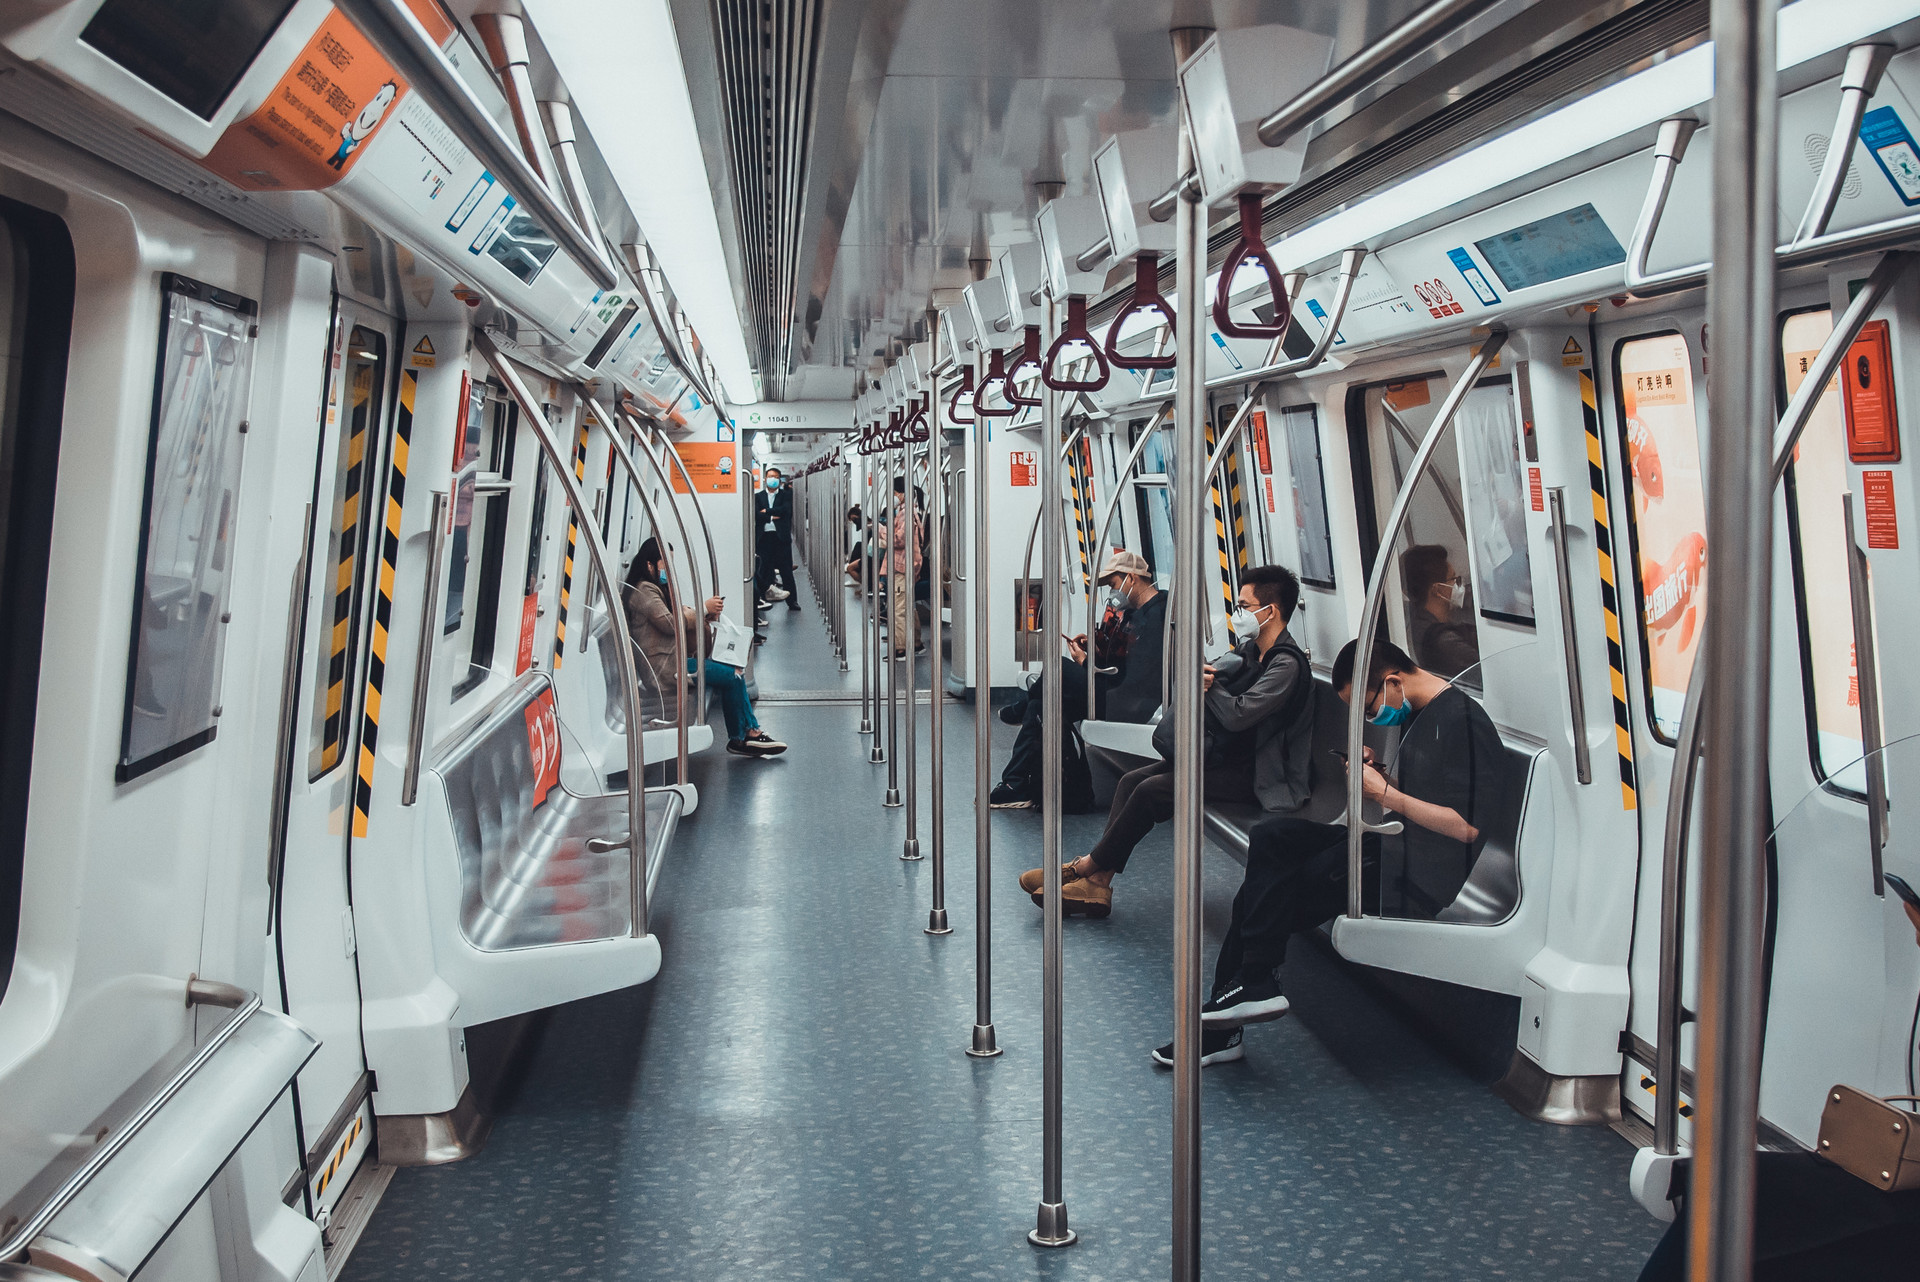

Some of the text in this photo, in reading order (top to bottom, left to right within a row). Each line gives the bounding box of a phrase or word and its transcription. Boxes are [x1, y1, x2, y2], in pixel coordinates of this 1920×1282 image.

[1637, 373, 1673, 391] 灯亮铃响
[1645, 561, 1687, 624] 出国旅行
[1225, 986, 1243, 998] balance
